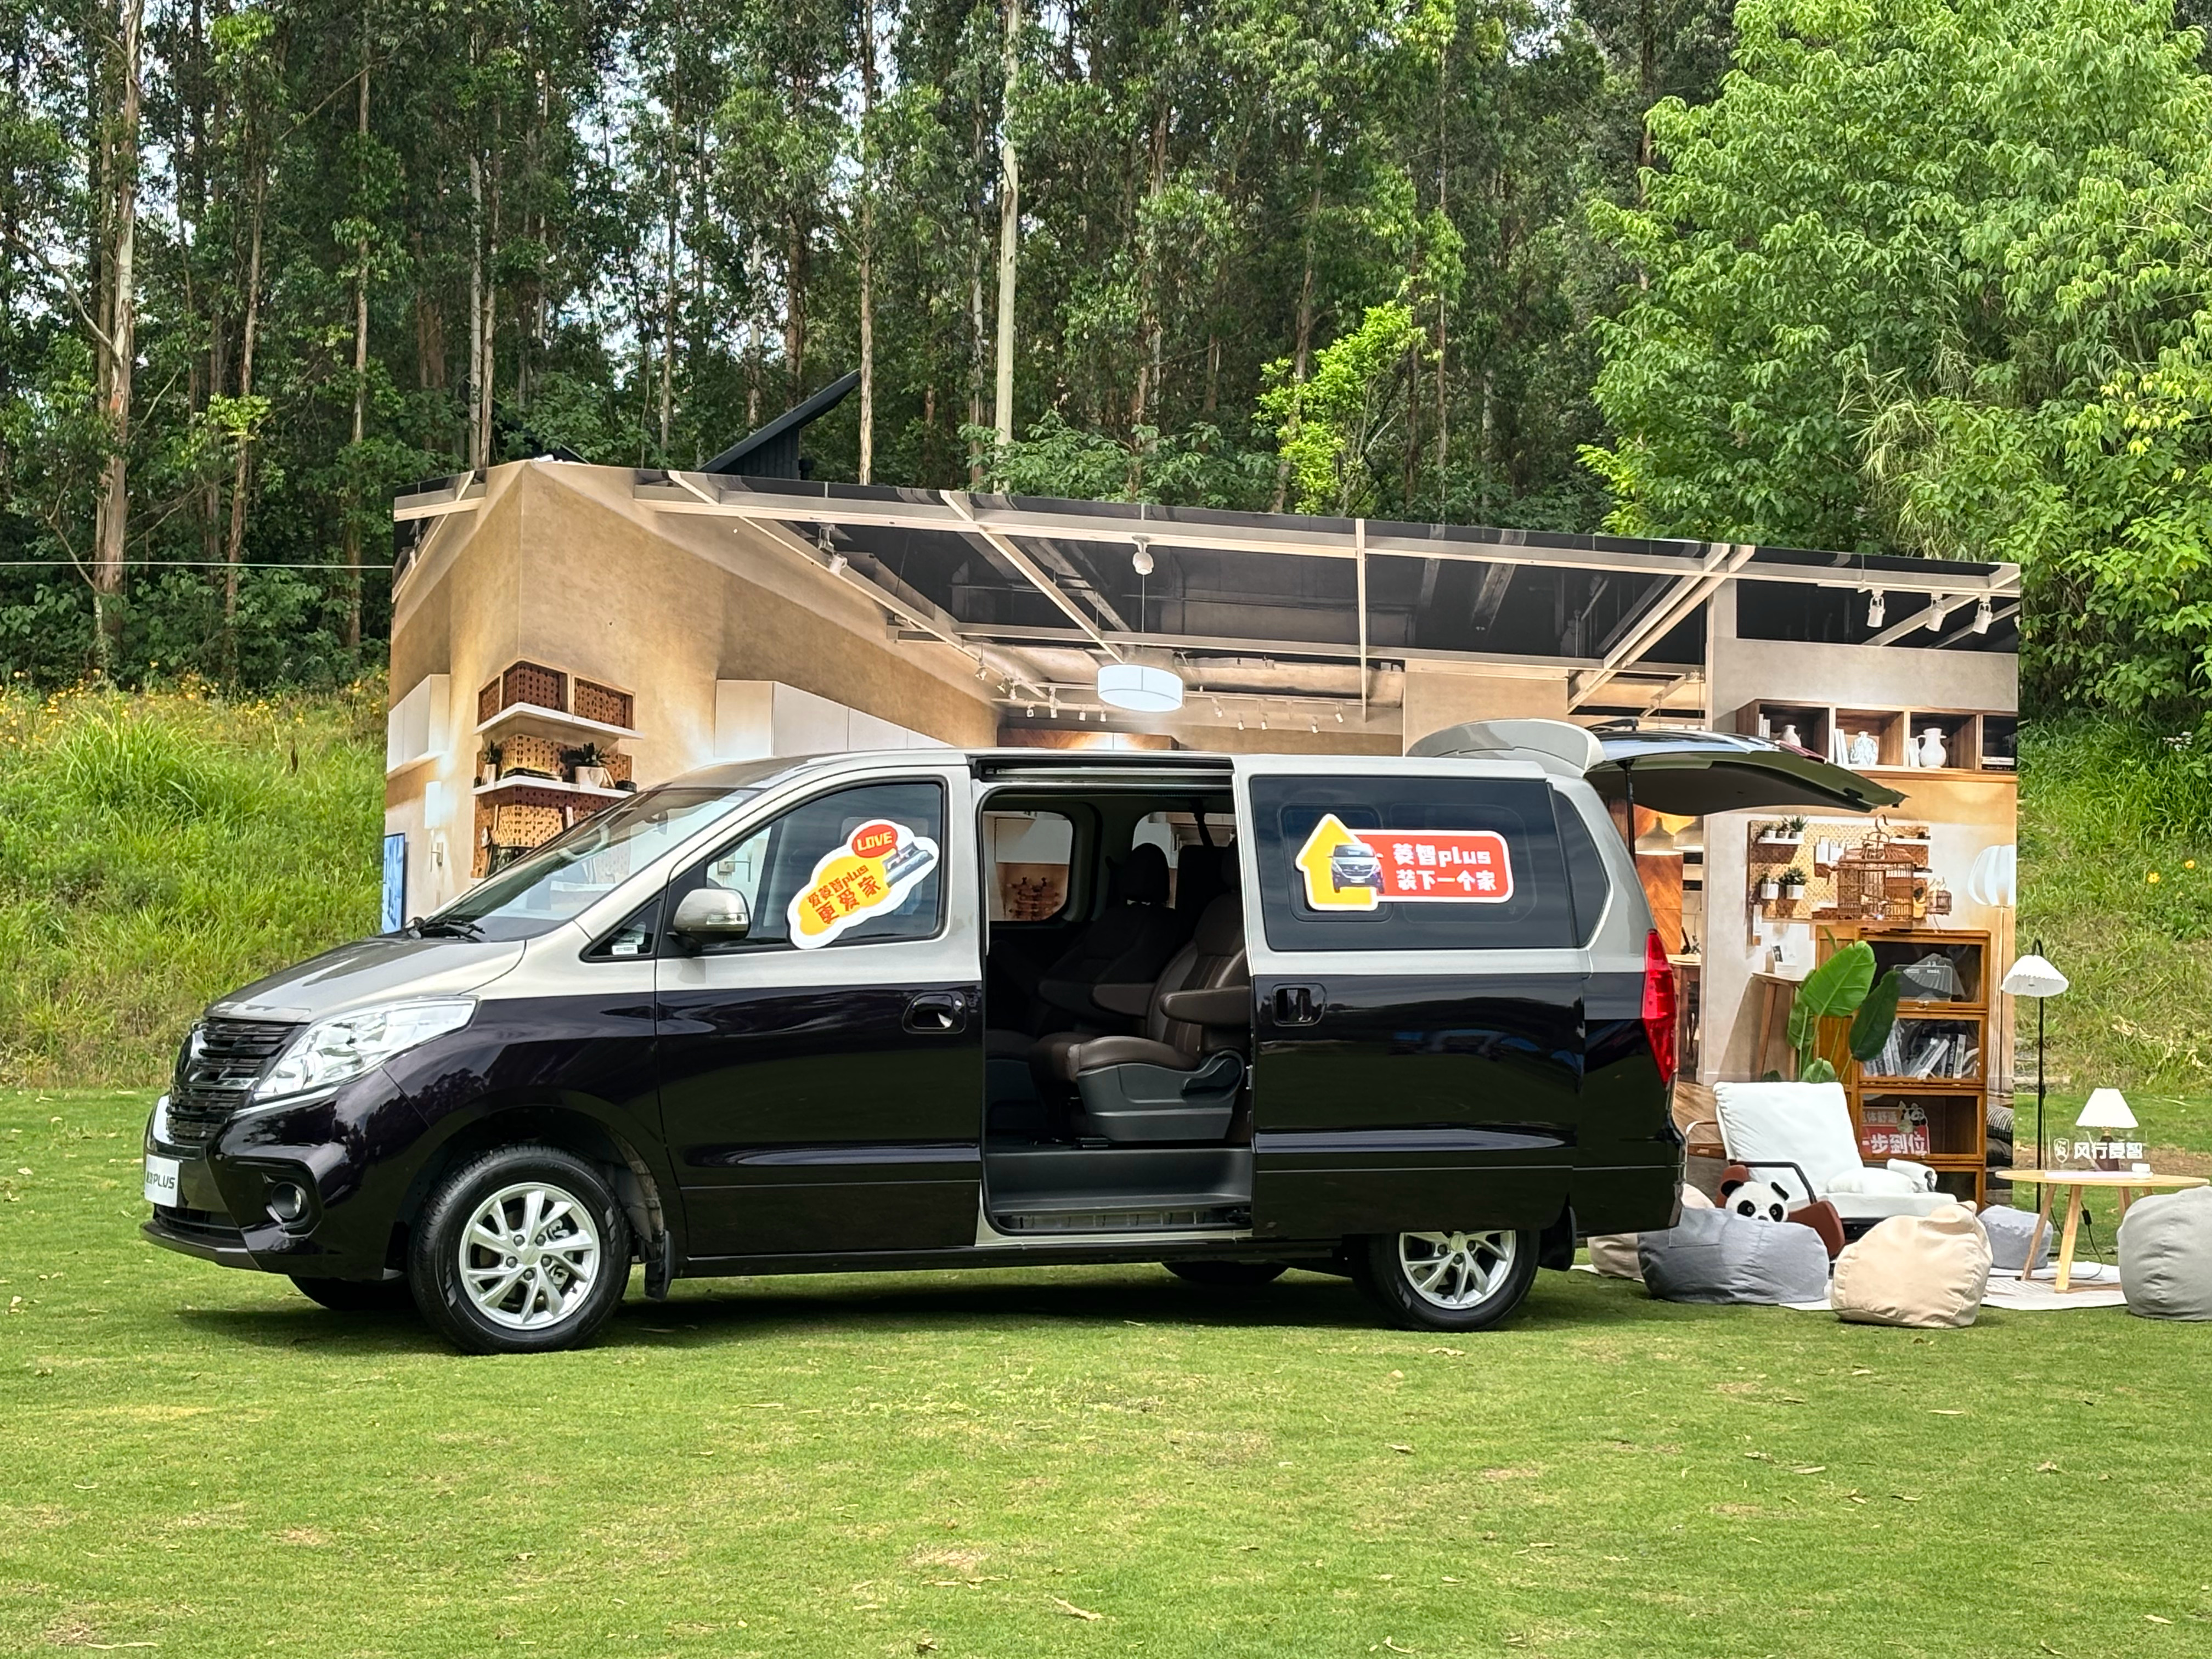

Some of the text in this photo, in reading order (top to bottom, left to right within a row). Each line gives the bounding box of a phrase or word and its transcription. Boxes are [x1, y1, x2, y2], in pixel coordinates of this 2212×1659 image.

[857, 831, 893, 851] LOVE
[1393, 843, 1491, 867] 菱智plus
[1397, 870, 1497, 891] 装下一个家
[815, 875, 881, 924] 更爱家
[2074, 1142, 2143, 1159] 风行菱智
